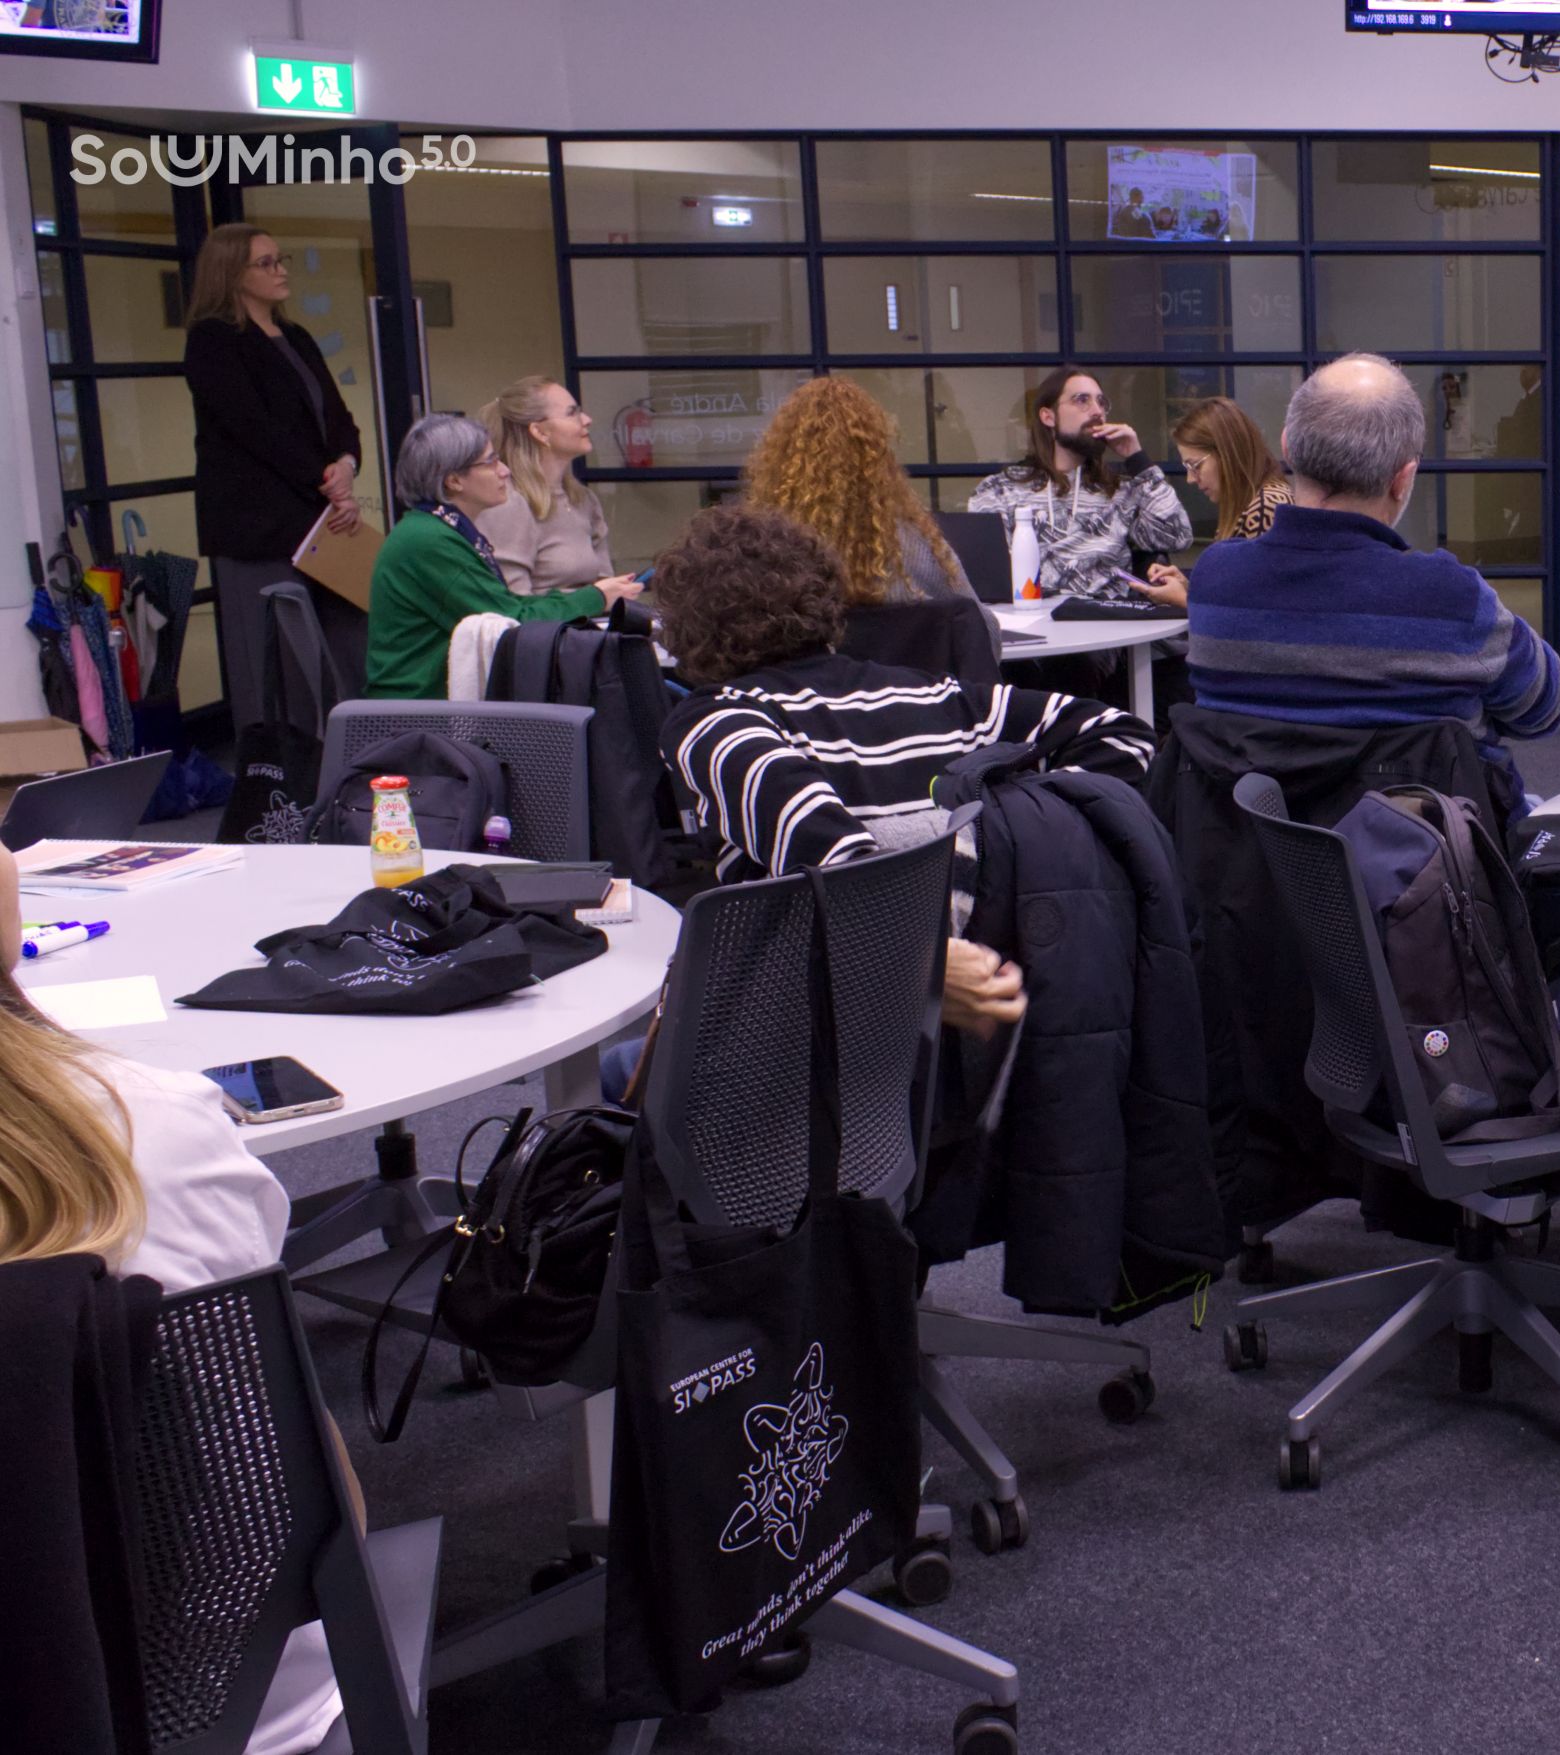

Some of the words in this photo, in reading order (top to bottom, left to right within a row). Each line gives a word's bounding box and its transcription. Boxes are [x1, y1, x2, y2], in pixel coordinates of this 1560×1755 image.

[1420, 14, 1436, 25] 3919
[670, 1367, 710, 1393] EUROPEAN
[709, 1354, 738, 1373] CENTRE
[711, 1358, 756, 1396] PASS
[702, 1627, 745, 1660] Great
[816, 1534, 846, 1570] think
